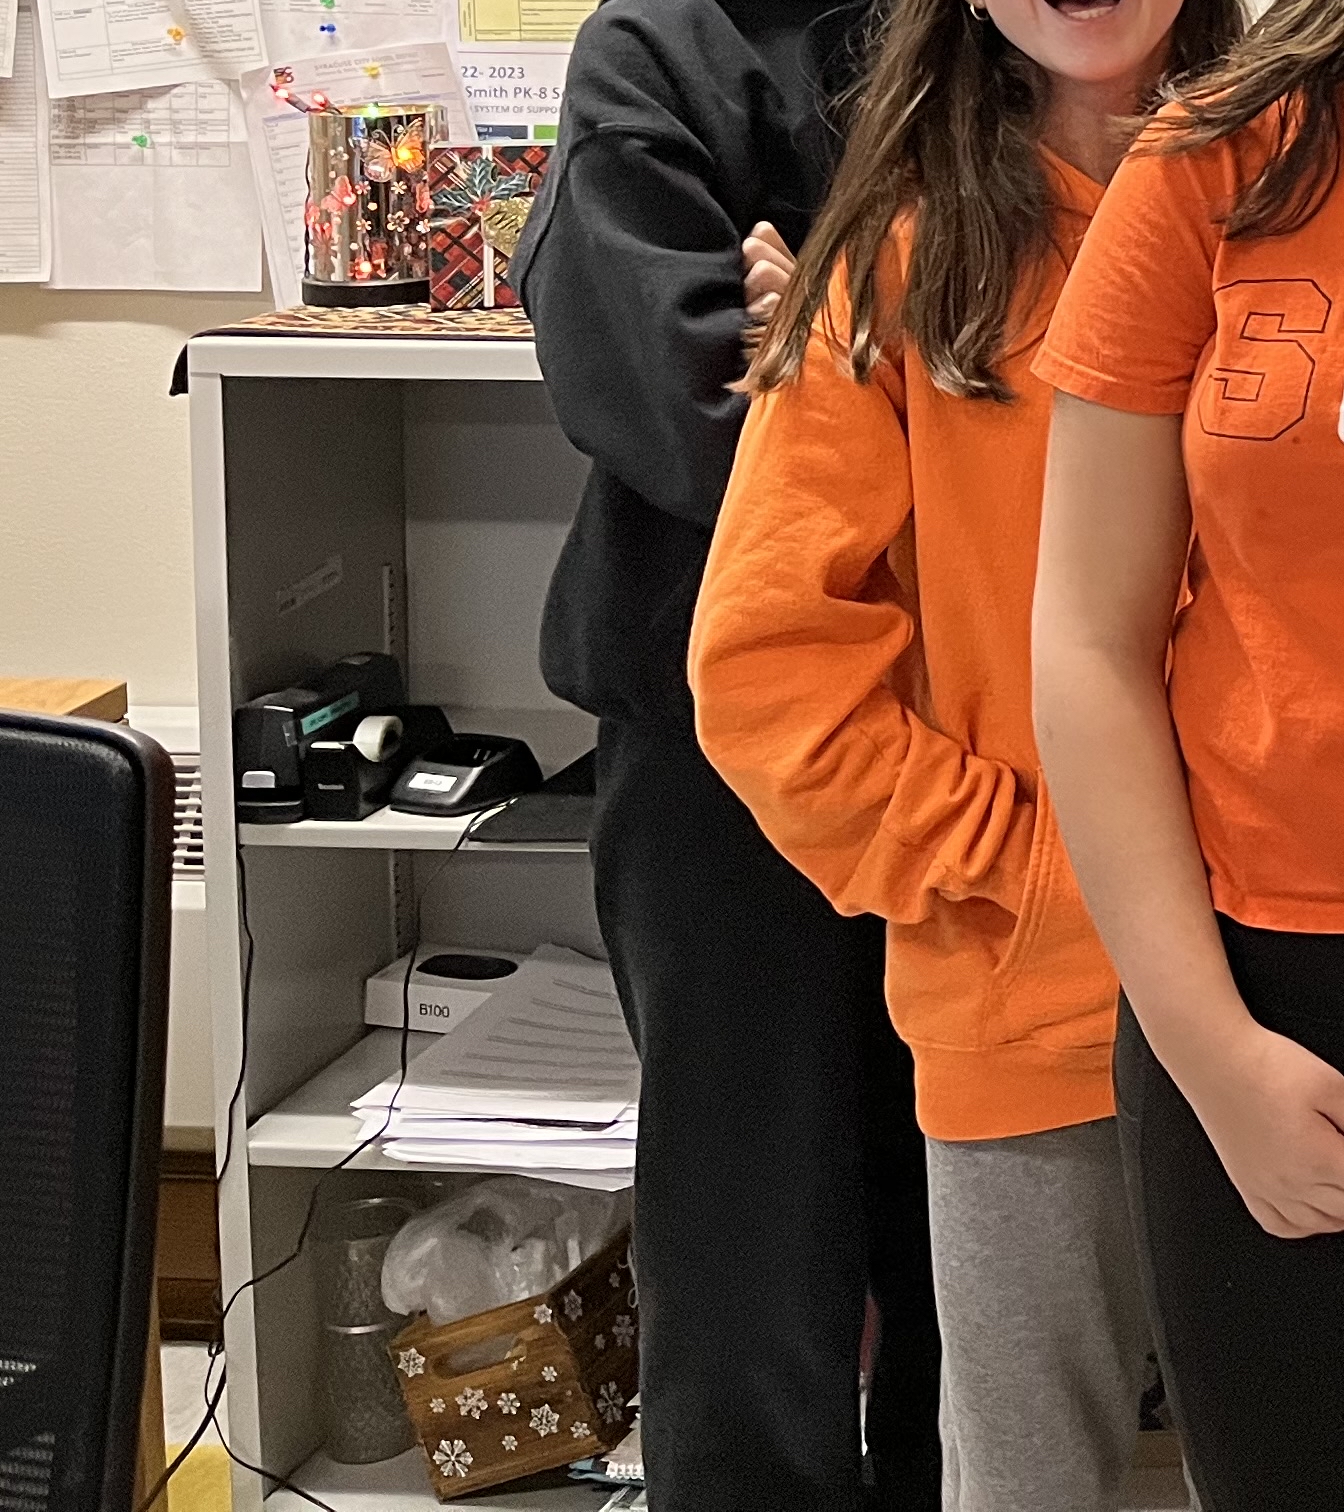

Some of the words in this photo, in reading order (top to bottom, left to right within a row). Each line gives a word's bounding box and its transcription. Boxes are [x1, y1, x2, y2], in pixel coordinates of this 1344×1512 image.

[488, 67, 526, 80] 2023
[464, 86, 509, 99] Smith
[513, 87, 548, 100] PK-8
[512, 105, 525, 114] OF
[419, 1003, 451, 1019] B100
